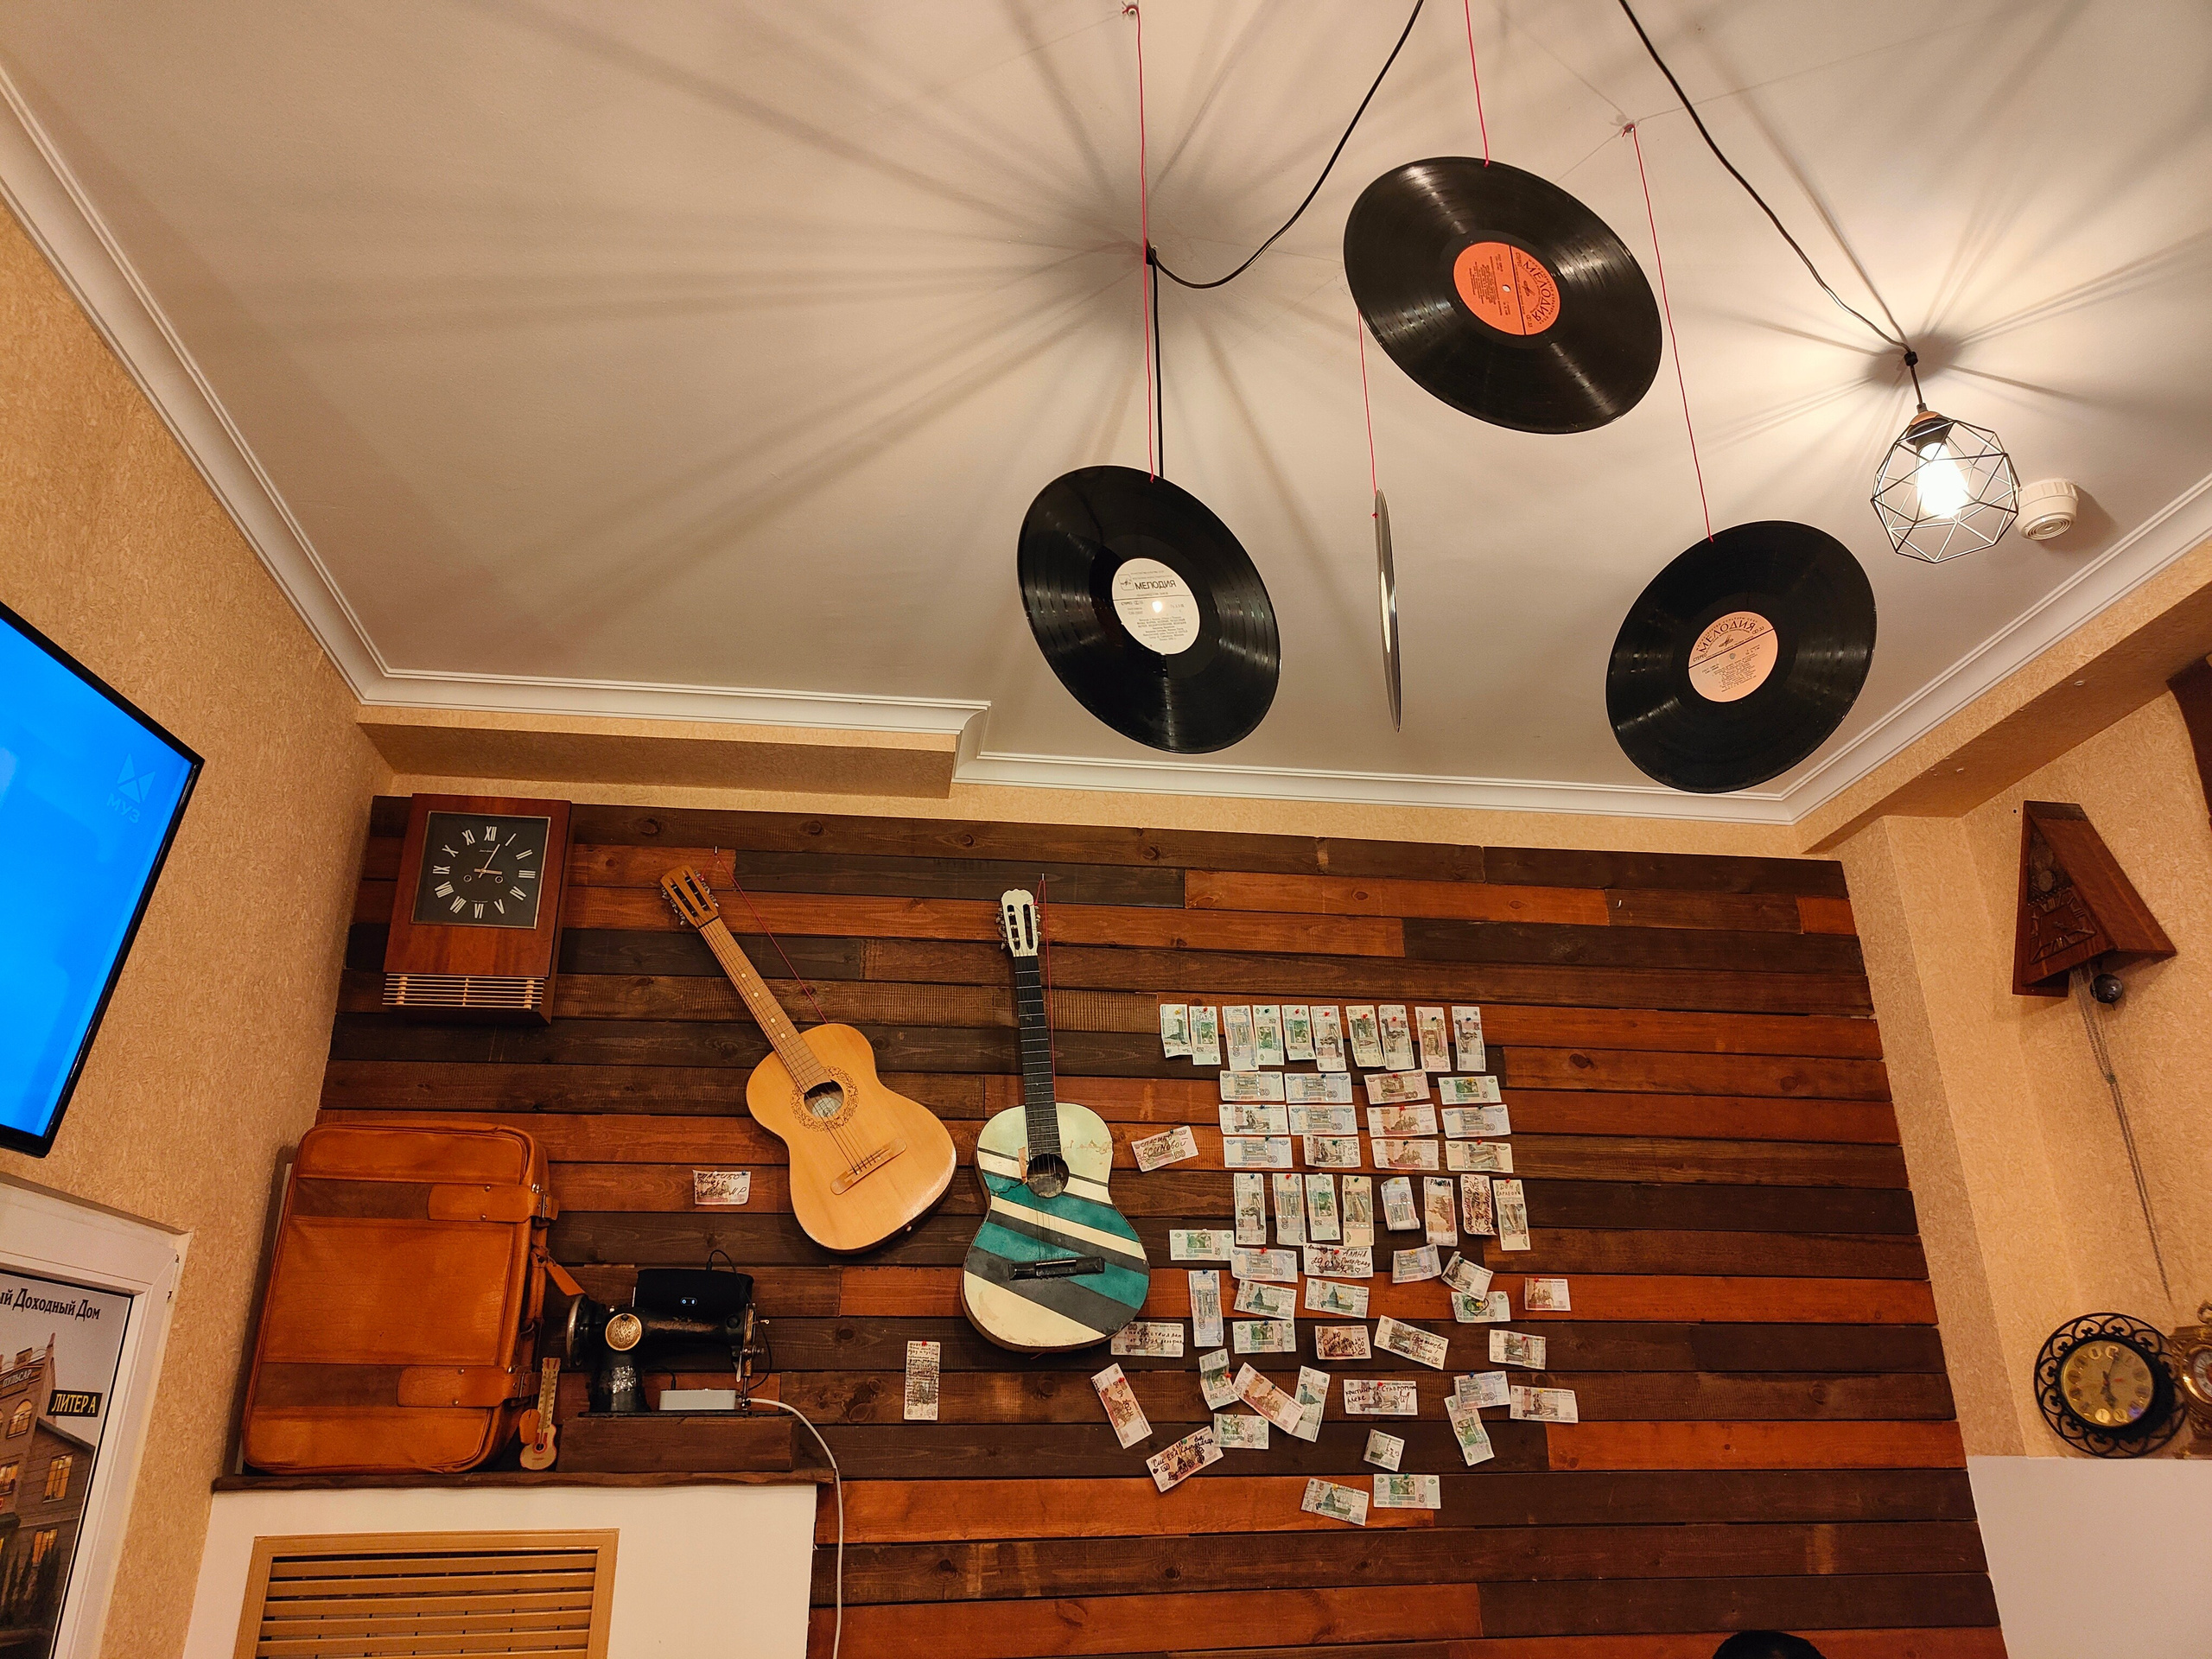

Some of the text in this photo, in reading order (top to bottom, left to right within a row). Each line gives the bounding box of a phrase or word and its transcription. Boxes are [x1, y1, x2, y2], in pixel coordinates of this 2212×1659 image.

[1523, 261, 1551, 321] МЕЛОДИЯ
[1135, 580, 1176, 590] МЕЛОДИЯ
[1699, 620, 1756, 653] МЕЛОДИЯ
[106, 792, 141, 823] МУЗ
[1326, 1090, 1338, 1098] 50
[1484, 1122, 1496, 1131] 50
[12, 1287, 76, 1316] Доходный
[75, 1300, 101, 1322] Дом
[3, 1369, 32, 1389] ПУЛЬСАР
[1482, 1392, 1496, 1401] 50
